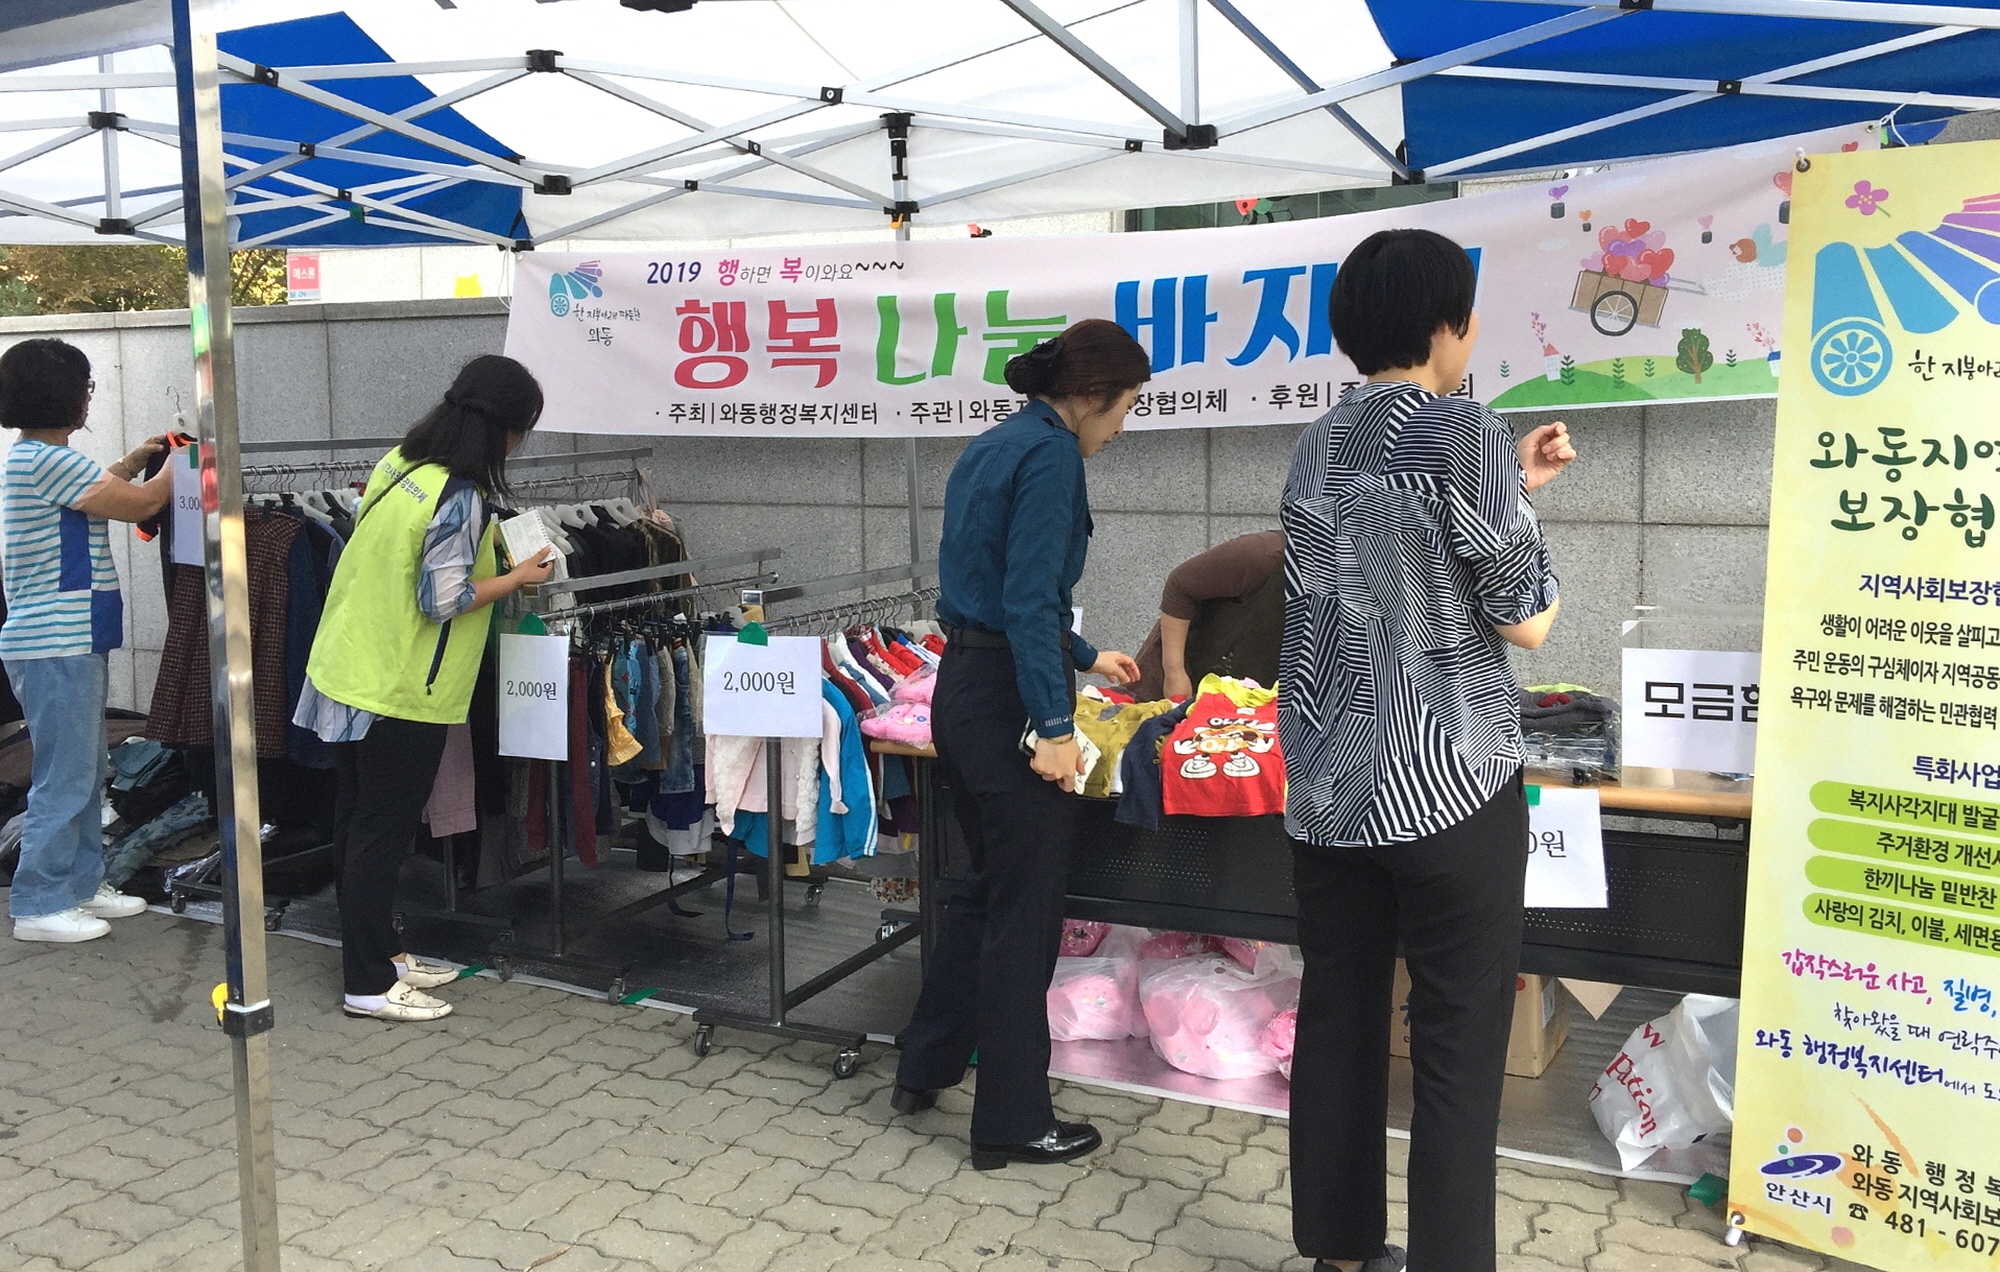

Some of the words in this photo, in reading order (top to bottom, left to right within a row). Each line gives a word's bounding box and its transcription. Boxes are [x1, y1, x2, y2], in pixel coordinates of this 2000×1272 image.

[646, 260, 702, 284] 2019
[718, 258, 772, 287] 행하면
[674, 297, 841, 389] 행복
[1908, 349, 1936, 381] 한
[1831, 487, 1995, 548] 보장협
[1820, 613, 1862, 639] 생활이
[1865, 617, 1907, 642] 어려운
[1910, 620, 1954, 646] 이웃을
[1956, 623, 2000, 649] 살피고
[723, 670, 796, 695] 2,000원
[1792, 649, 1820, 673] 주민
[1823, 651, 1864, 678] 운동의
[1867, 655, 1939, 685] 구심체이자
[506, 680, 558, 700] 2,000원
[1790, 686, 1832, 712] 욕구와
[1834, 690, 1877, 717] 문제를
[1879, 695, 1936, 724] 해결하는
[1939, 701, 1997, 731] 민관협력
[1848, 788, 1958, 826] 복지사각지대
[1962, 804, 2000, 831] 발굴
[1876, 831, 1949, 864] 주거환경
[1864, 867, 1936, 900] 한끼나눔
[1940, 880, 1998, 911] 밑반찬
[1814, 898, 1864, 927] 사랑의
[1868, 906, 1906, 936] 김치,
[1911, 914, 1949, 943] 이불,
[1781, 948, 1881, 991] 갑작스러운
[1886, 971, 1932, 1006] 사고,
[1943, 977, 1998, 1019] 질병,
[1833, 1001, 1902, 1042] 찾아왔을
[1906, 1023, 1931, 1040] 때
[1755, 1029, 1793, 1058] 와동
[1765, 1182, 1832, 1215] 안산시
